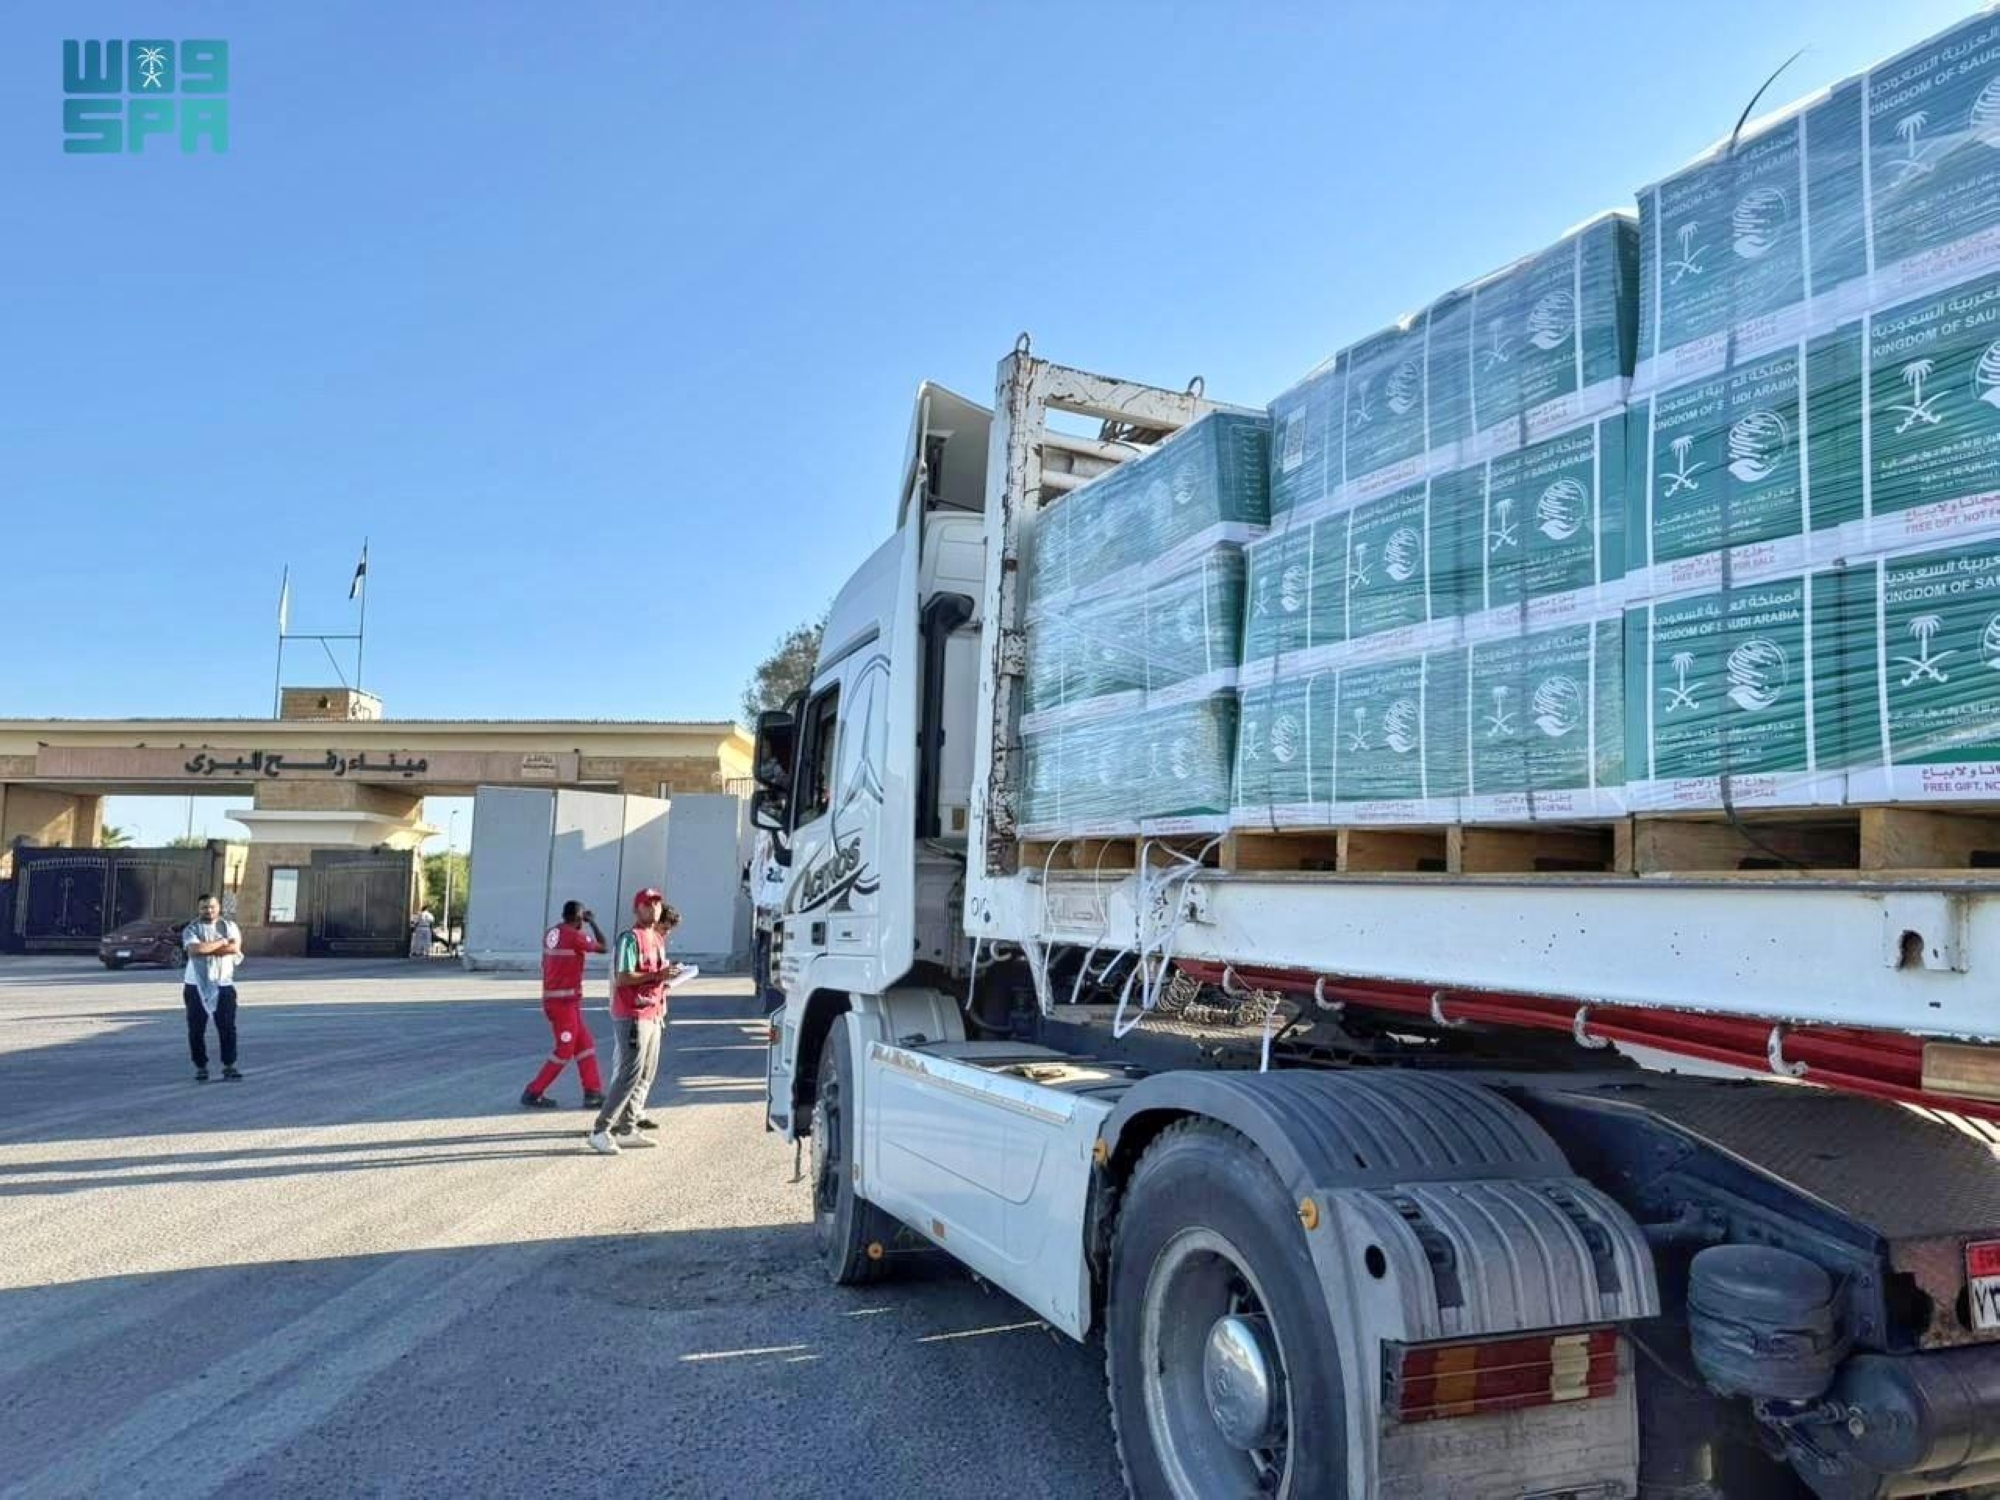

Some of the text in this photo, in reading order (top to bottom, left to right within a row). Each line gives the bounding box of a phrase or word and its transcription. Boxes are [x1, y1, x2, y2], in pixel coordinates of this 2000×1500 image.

[1941, 319, 1961, 336] OF
[1951, 580, 1969, 594] OF
[1700, 621, 1717, 635] OF
[1752, 608, 1801, 626] ARABIA
[264, 749, 347, 777] رفح
[349, 752, 428, 778] ميناء
[1923, 781, 1953, 793] FREE
